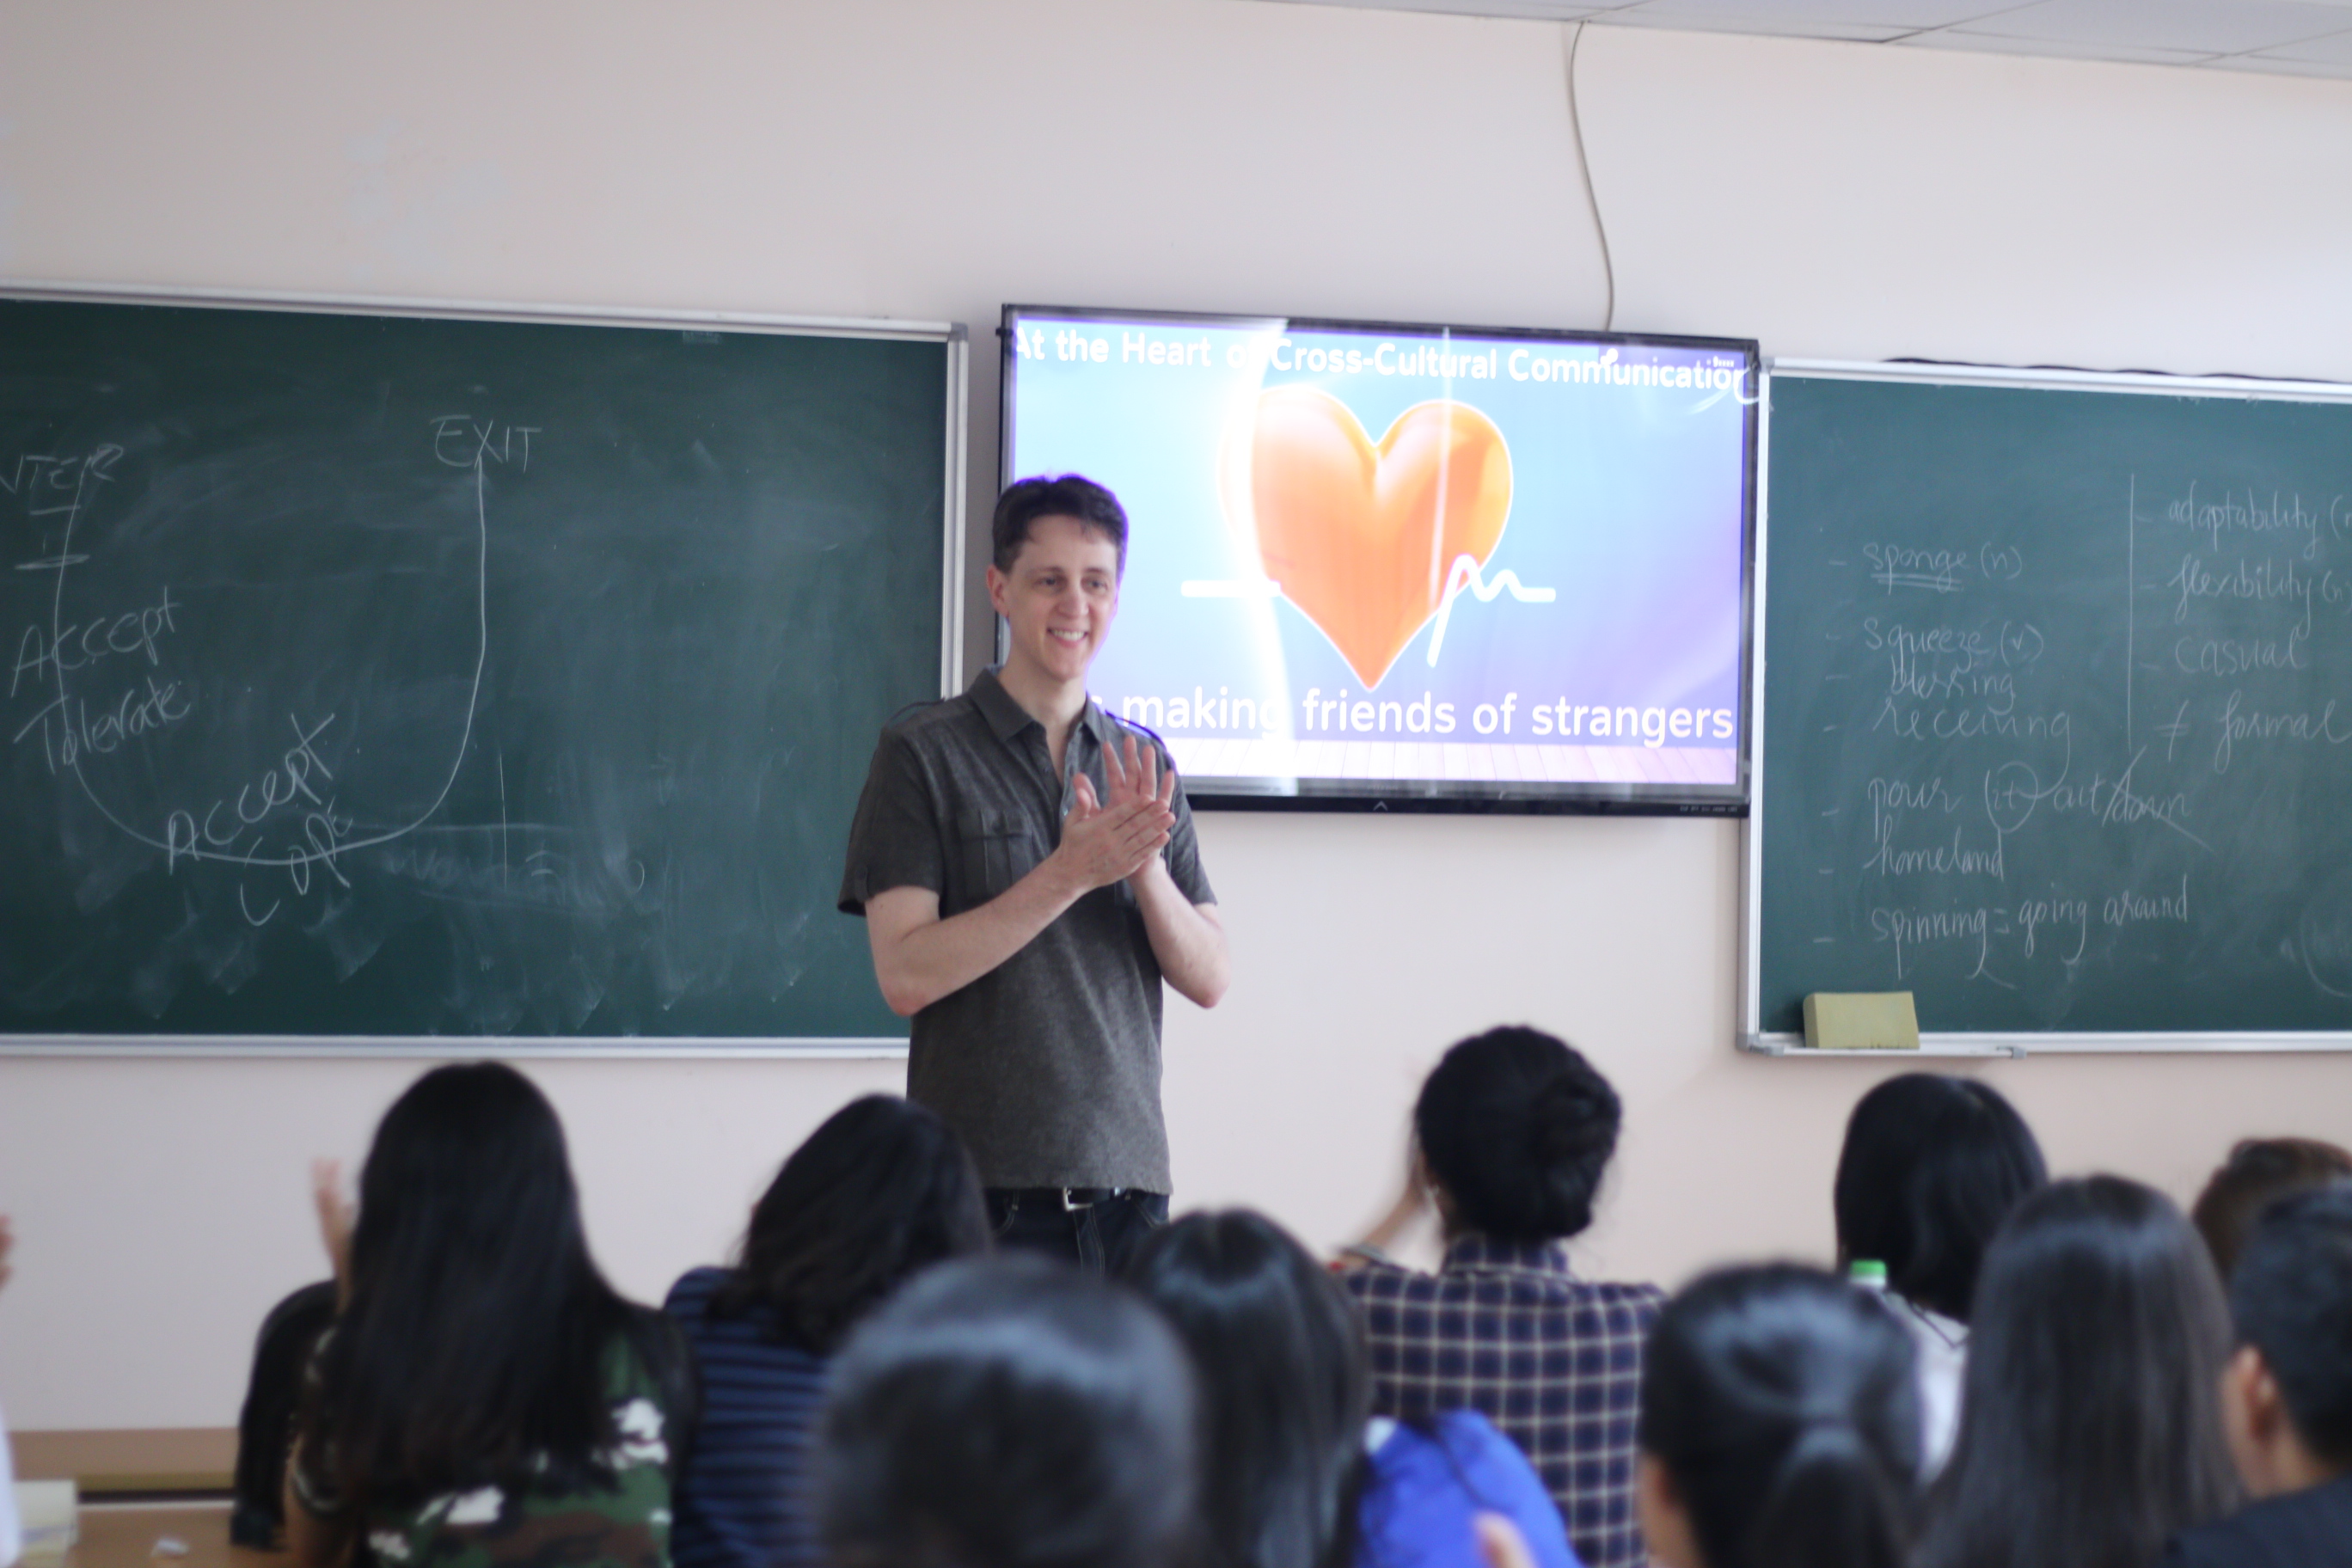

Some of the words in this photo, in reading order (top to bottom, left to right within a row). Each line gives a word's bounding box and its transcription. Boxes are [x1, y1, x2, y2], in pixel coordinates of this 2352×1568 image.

[1015, 326, 1045, 361] At
[1055, 329, 1110, 363] the
[1122, 331, 1212, 368] Heart
[1271, 338, 1498, 380] Cross-Cultural
[430, 413, 543, 474] EXIT
[2168, 480, 2320, 560] adaptability
[1863, 542, 1969, 596] sponge
[2166, 553, 2312, 640] flexibility
[10, 585, 182, 699] Accept
[13, 676, 191, 775] Tolerate
[1123, 685, 1283, 741] making
[1302, 687, 1456, 735] friends
[1472, 692, 1517, 735] of
[1532, 695, 1734, 749] strangers
[2214, 688, 2352, 775] formal
[2104, 873, 2188, 928] around
